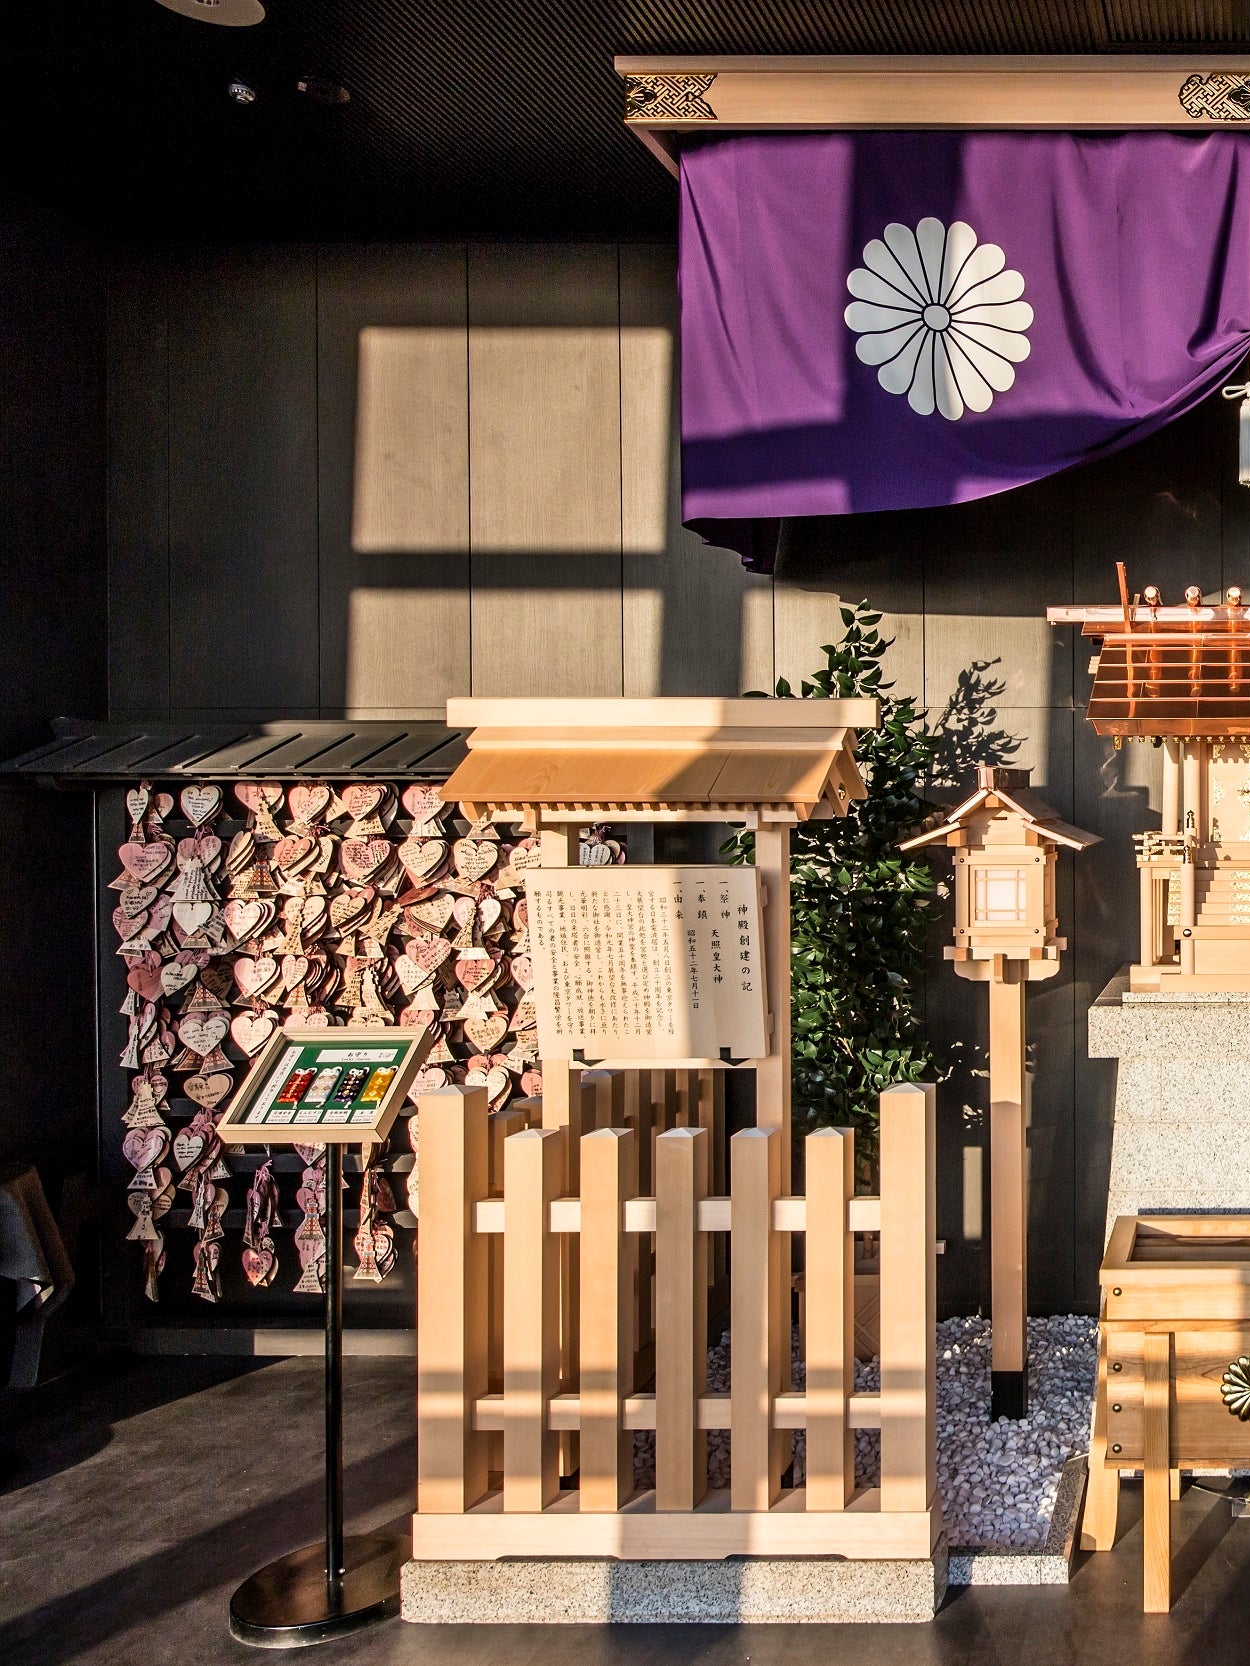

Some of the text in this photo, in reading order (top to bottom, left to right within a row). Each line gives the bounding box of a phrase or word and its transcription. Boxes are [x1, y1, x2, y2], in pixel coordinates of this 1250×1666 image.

[687, 930, 699, 1008] 昭和五十二年七月十一日
[711, 929, 723, 984] 天照皇大神
[737, 904, 752, 992] 神殿創建の記
